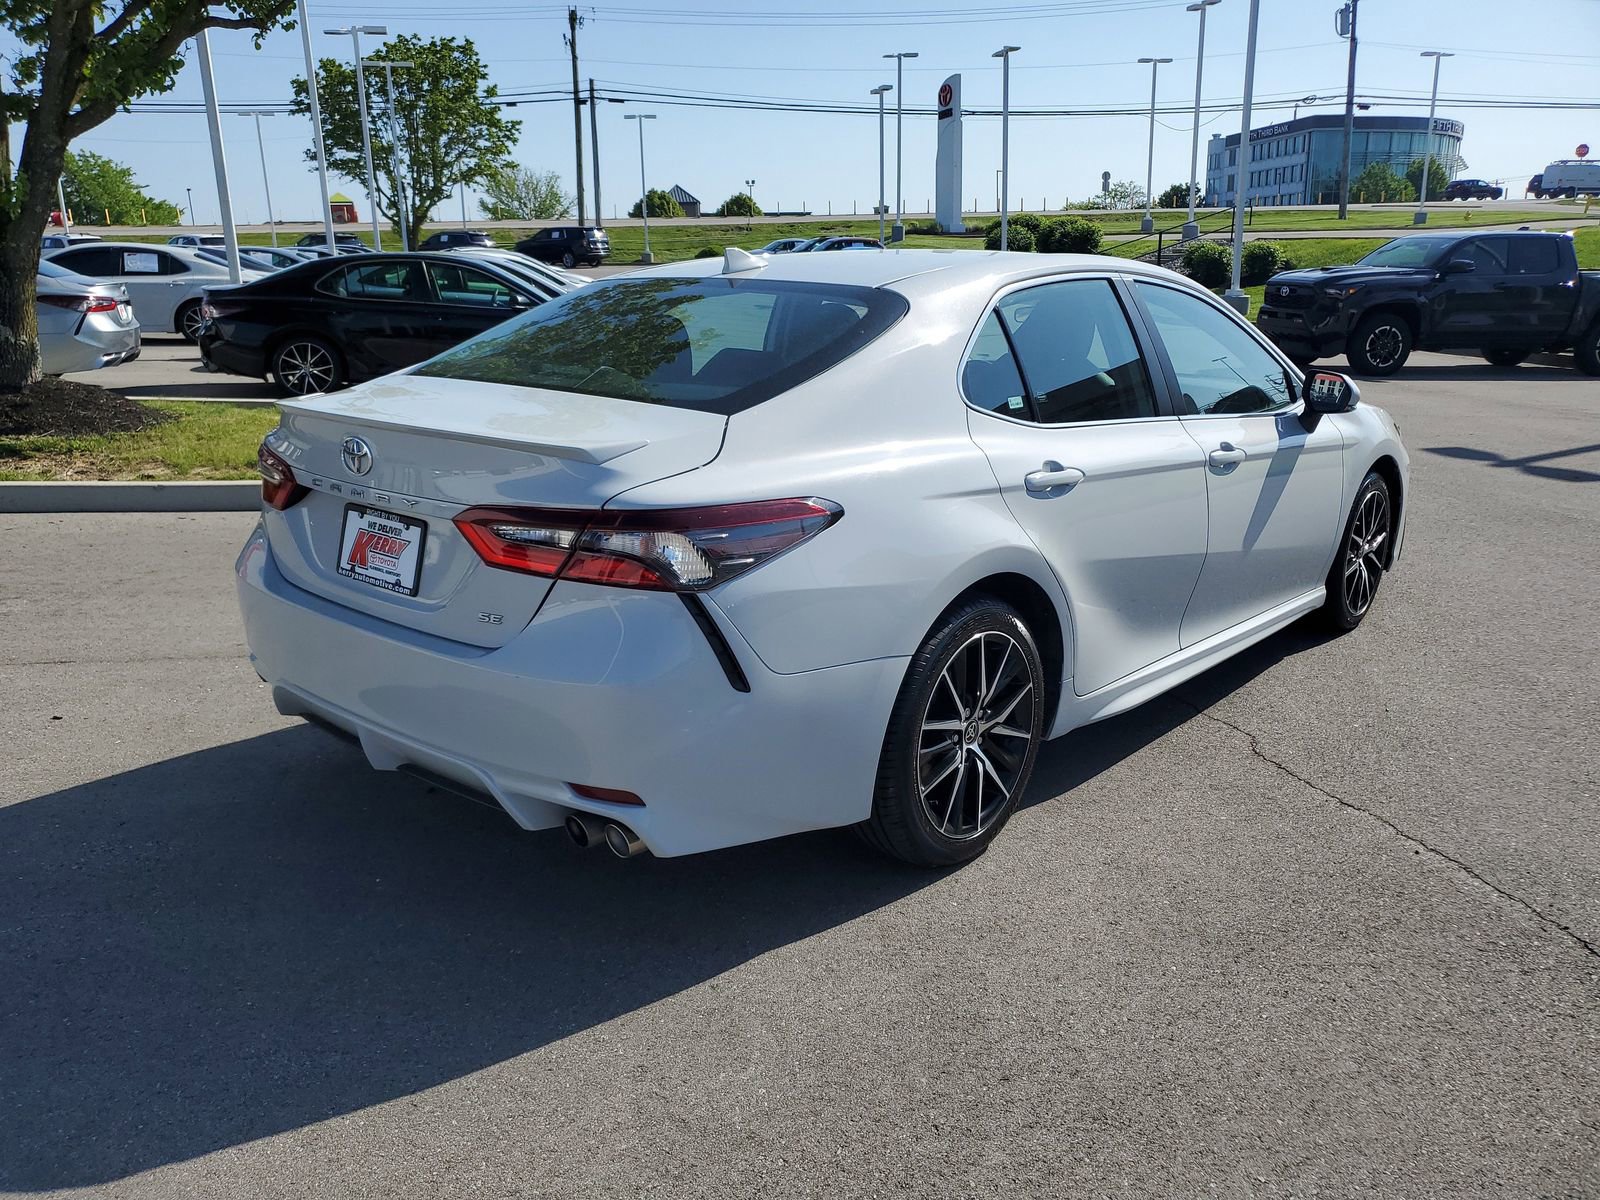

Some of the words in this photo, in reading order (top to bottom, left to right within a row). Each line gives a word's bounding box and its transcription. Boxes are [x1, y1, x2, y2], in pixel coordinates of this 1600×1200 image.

[1274, 124, 1289, 135] BANK
[312, 478, 419, 508] CAMRY
[381, 512, 389, 520] BY
[389, 514, 400, 522] YOU
[367, 520, 377, 530] WE
[377, 522, 403, 537] DELIVER
[348, 529, 409, 568] KERRY
[377, 556, 397, 568] TOYOTA
[338, 568, 411, 595] kerryautomotive.com
[479, 611, 504, 625] SE
